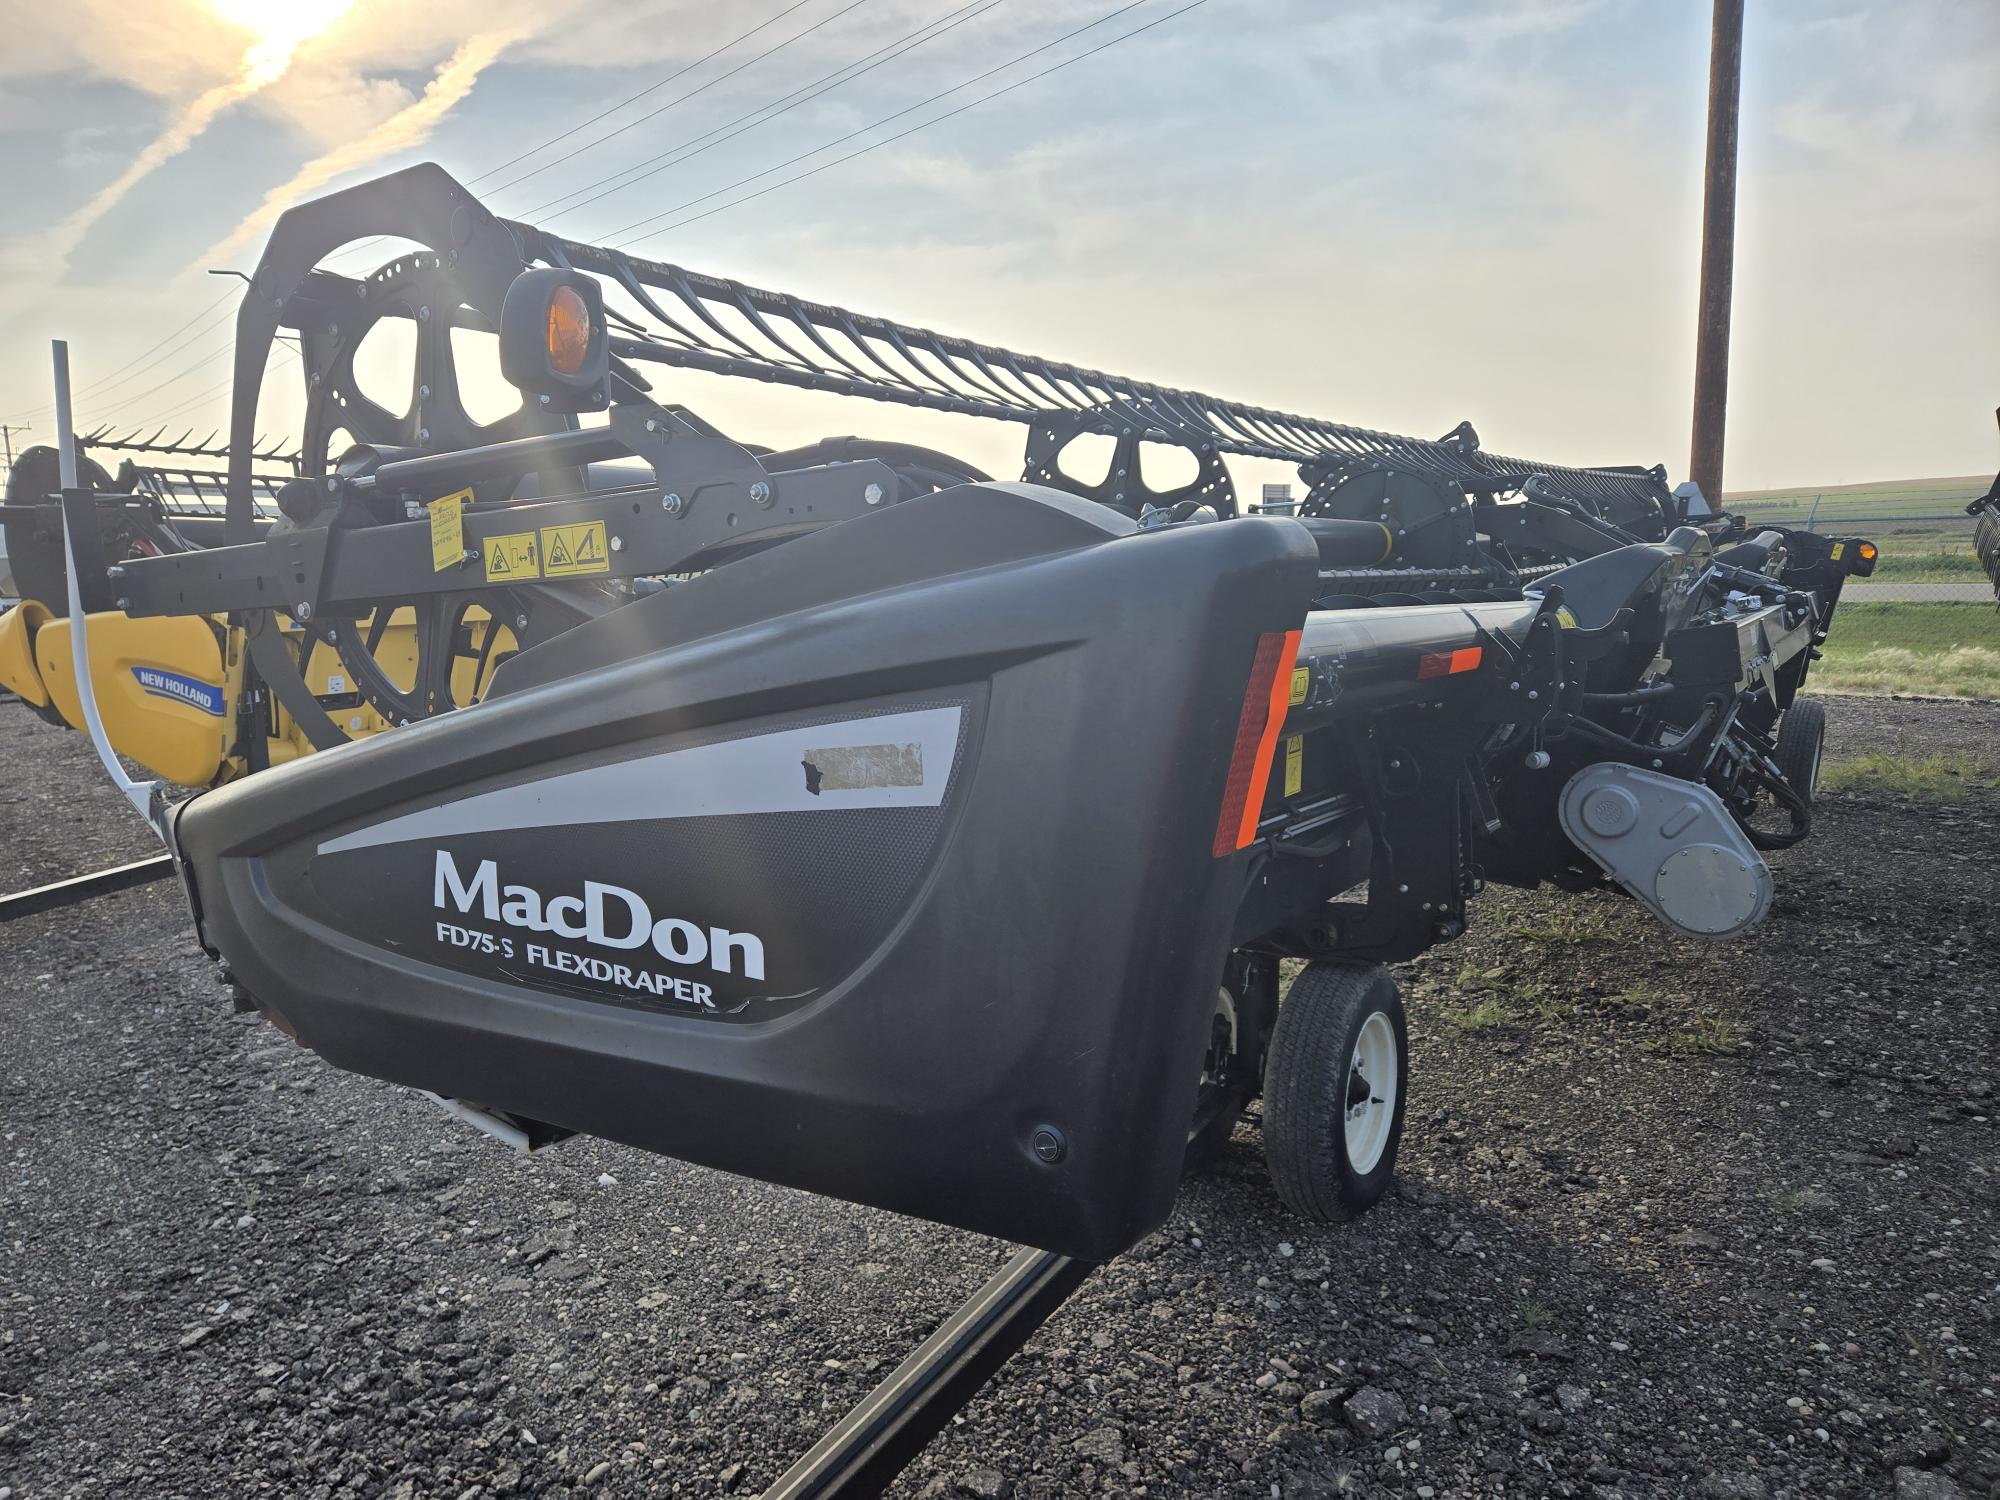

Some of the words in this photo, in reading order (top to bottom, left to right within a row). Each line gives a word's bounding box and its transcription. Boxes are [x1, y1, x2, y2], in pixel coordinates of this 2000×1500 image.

[141, 671, 163, 688] NEW
[165, 678, 211, 708] HOLLAND
[434, 850, 765, 981] MacDon
[436, 922, 514, 958] FD75-S
[526, 943, 716, 1008] FLEXDRAPER
